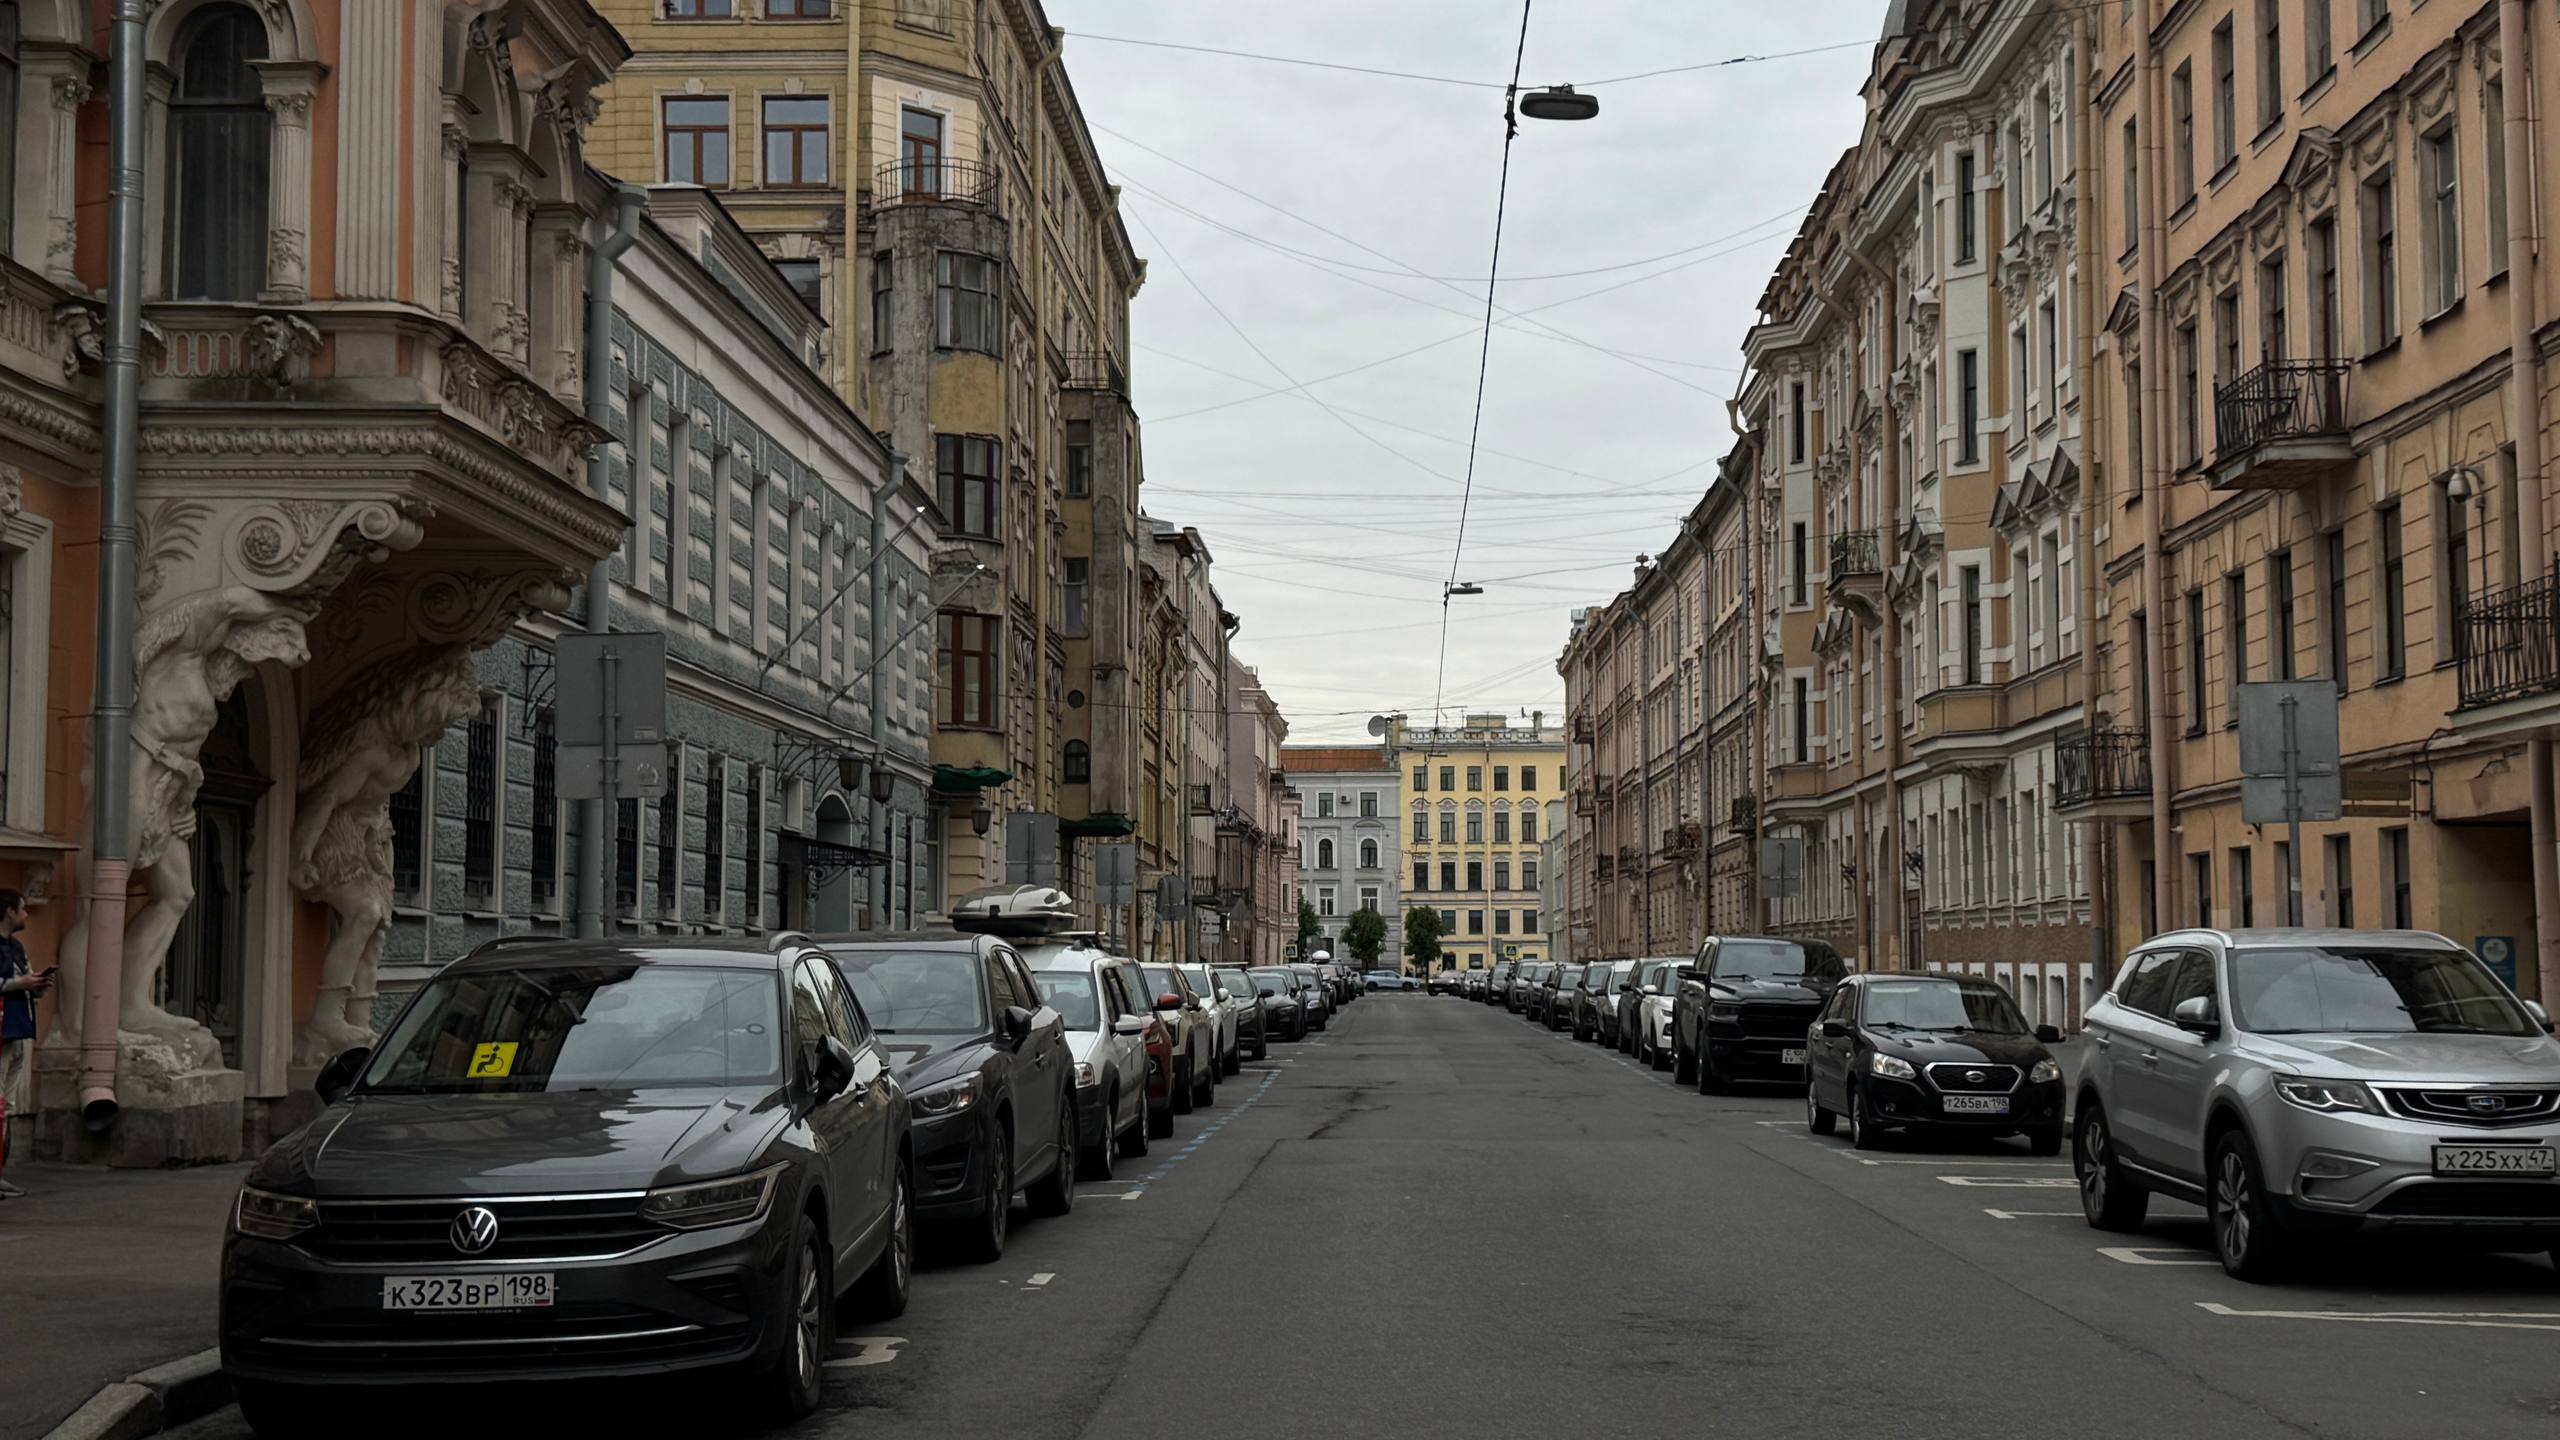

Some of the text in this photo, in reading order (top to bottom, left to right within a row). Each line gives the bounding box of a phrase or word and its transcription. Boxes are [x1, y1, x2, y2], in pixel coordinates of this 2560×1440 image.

[2529, 1150, 2547, 1164] 47
[506, 1275, 547, 1296] 198
[512, 1296, 534, 1305] RUS
